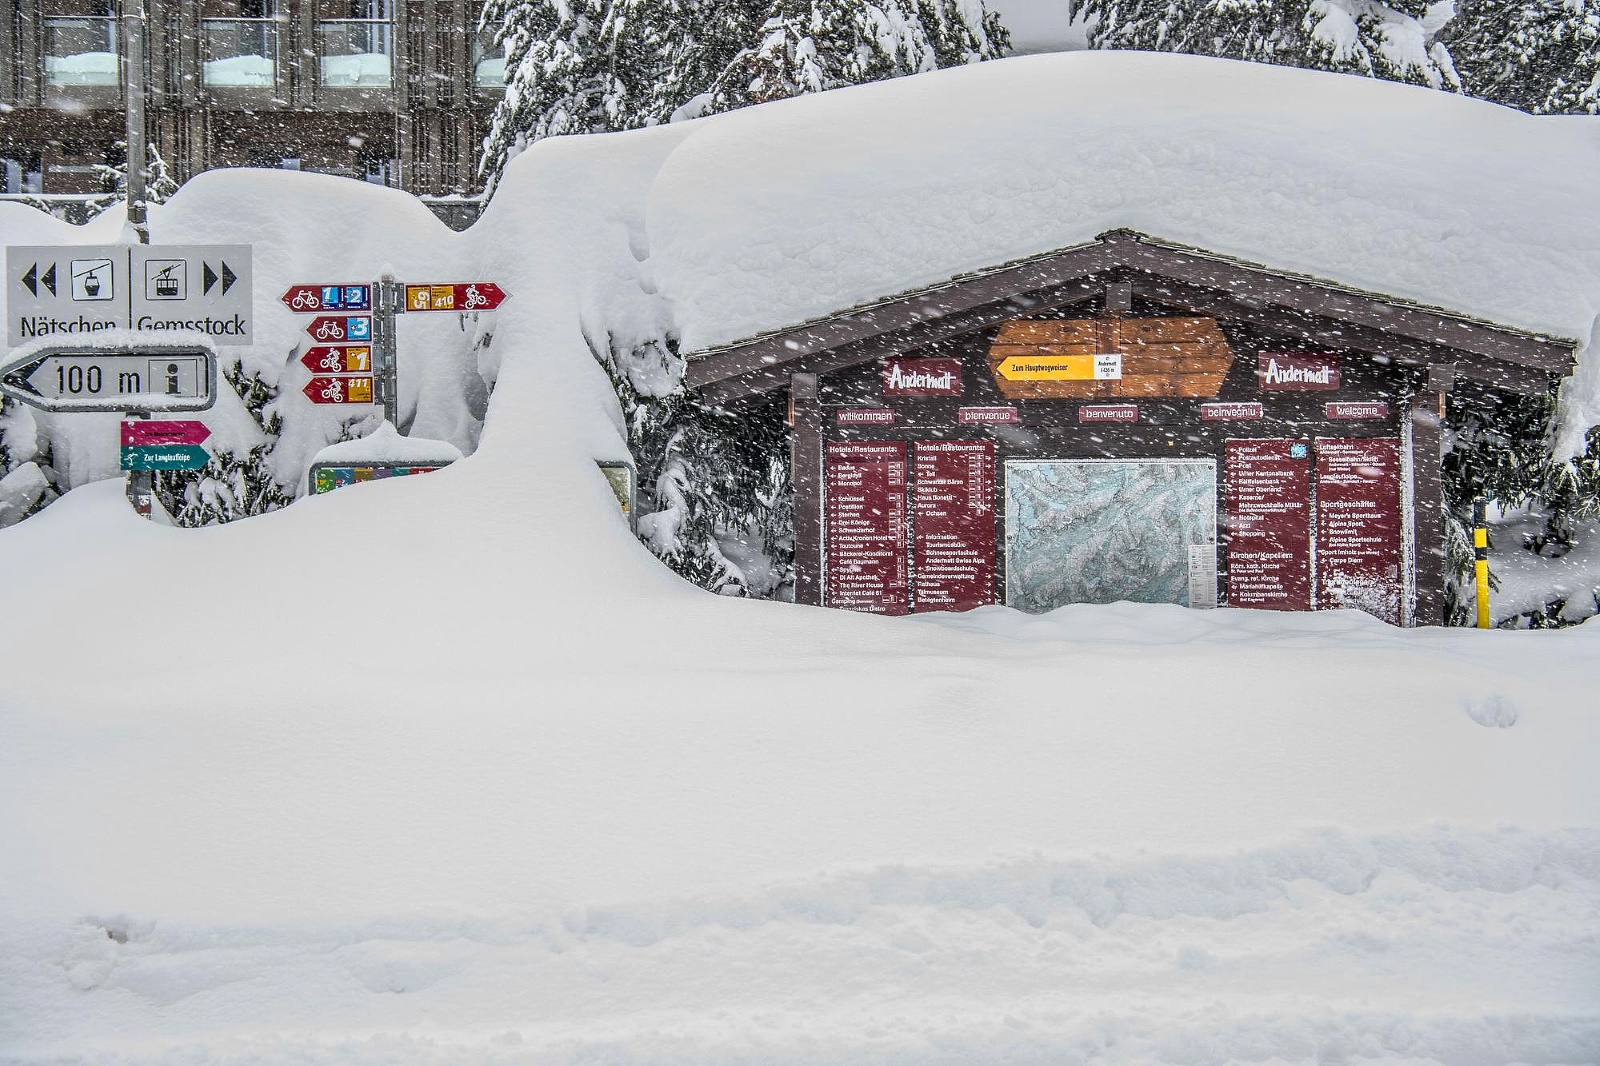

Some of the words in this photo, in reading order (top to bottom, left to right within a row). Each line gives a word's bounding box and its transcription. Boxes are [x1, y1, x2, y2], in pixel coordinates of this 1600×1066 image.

[351, 289, 361, 303] 2
[435, 295, 454, 307] 410
[21, 315, 116, 337] Nätschen
[137, 314, 246, 335] Gemsstock
[354, 318, 369, 335] 3
[356, 352, 367, 370] 1
[889, 364, 956, 389] Andermatt
[1264, 358, 1332, 384] Andermatt
[57, 365, 101, 394] 100
[119, 372, 141, 393] m
[348, 379, 367, 387] 411
[839, 411, 892, 421] willkommen
[965, 411, 1010, 420] bienvenue
[1086, 409, 1133, 418] benvenuto
[1336, 407, 1378, 415] welcome
[144, 454, 153, 462] Zur
